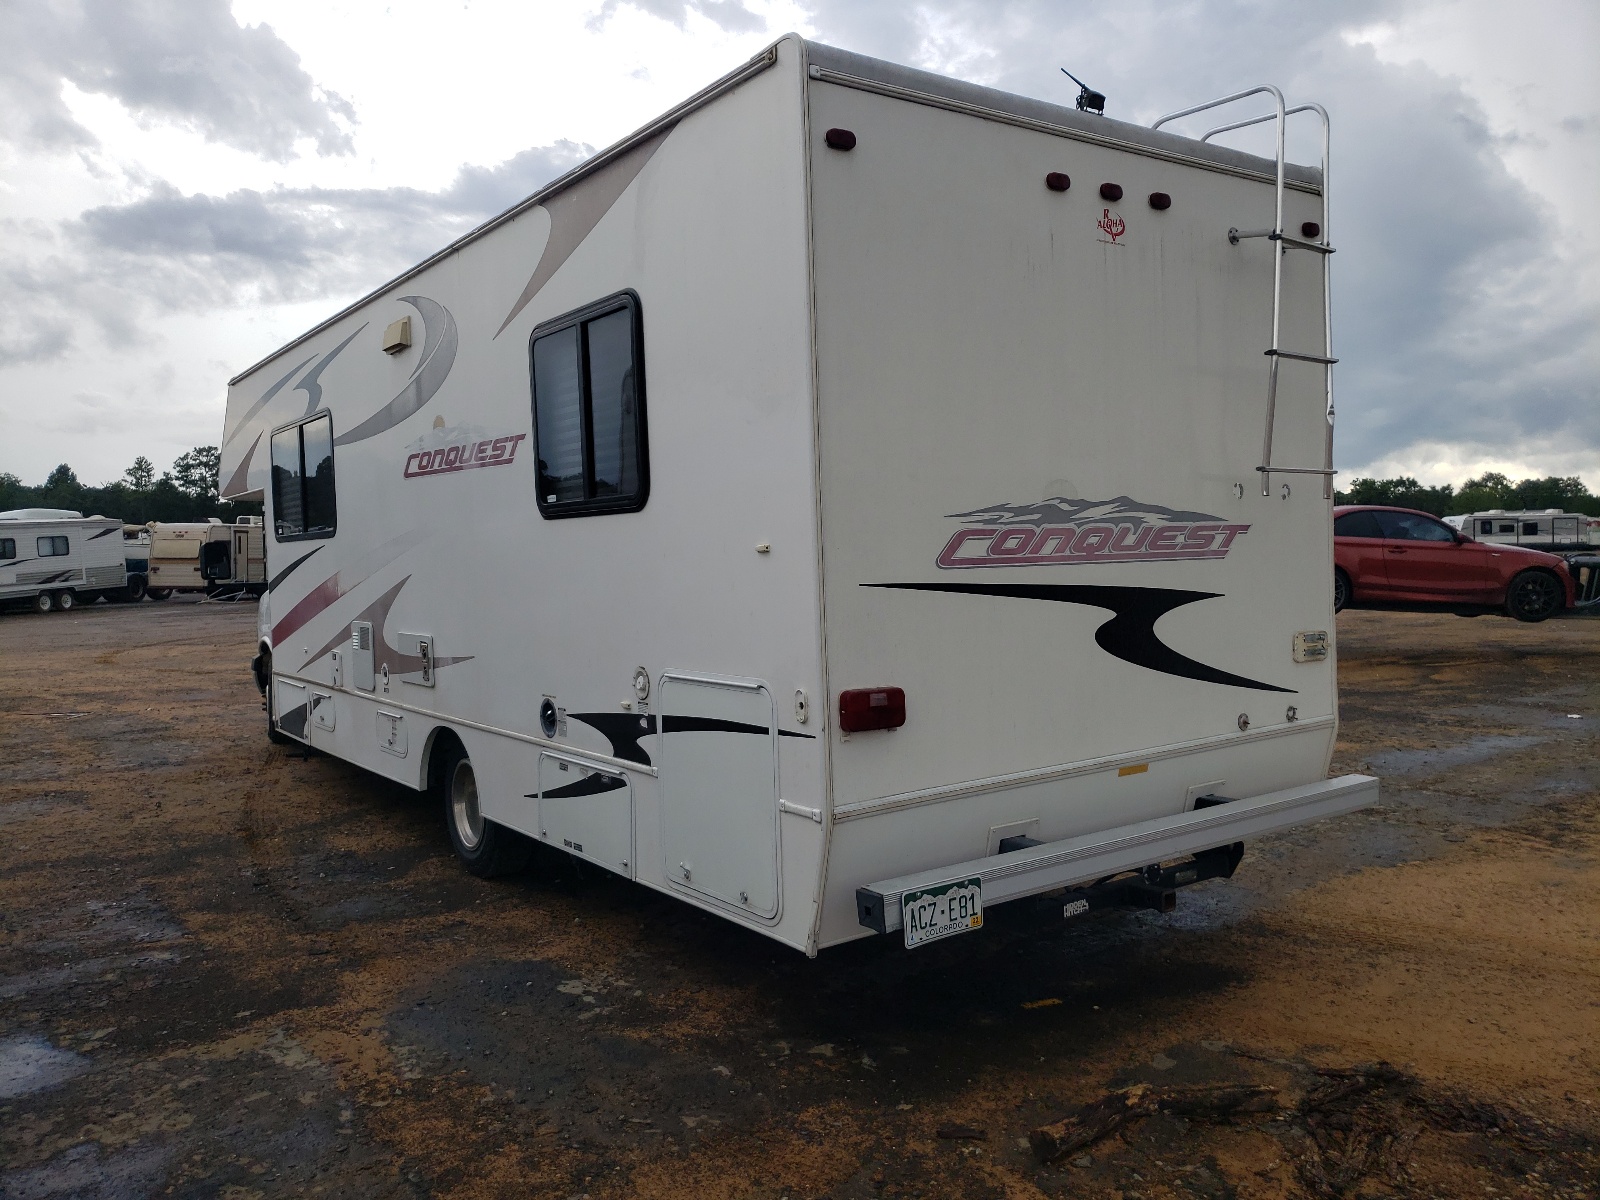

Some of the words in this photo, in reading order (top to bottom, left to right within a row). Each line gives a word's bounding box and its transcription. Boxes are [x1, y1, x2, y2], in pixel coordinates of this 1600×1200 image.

[1097, 218, 1123, 229] ALOHA
[404, 433, 526, 478] CONQUEST
[936, 523, 1251, 569] CONQUEST
[925, 921, 964, 938] COLORADO
